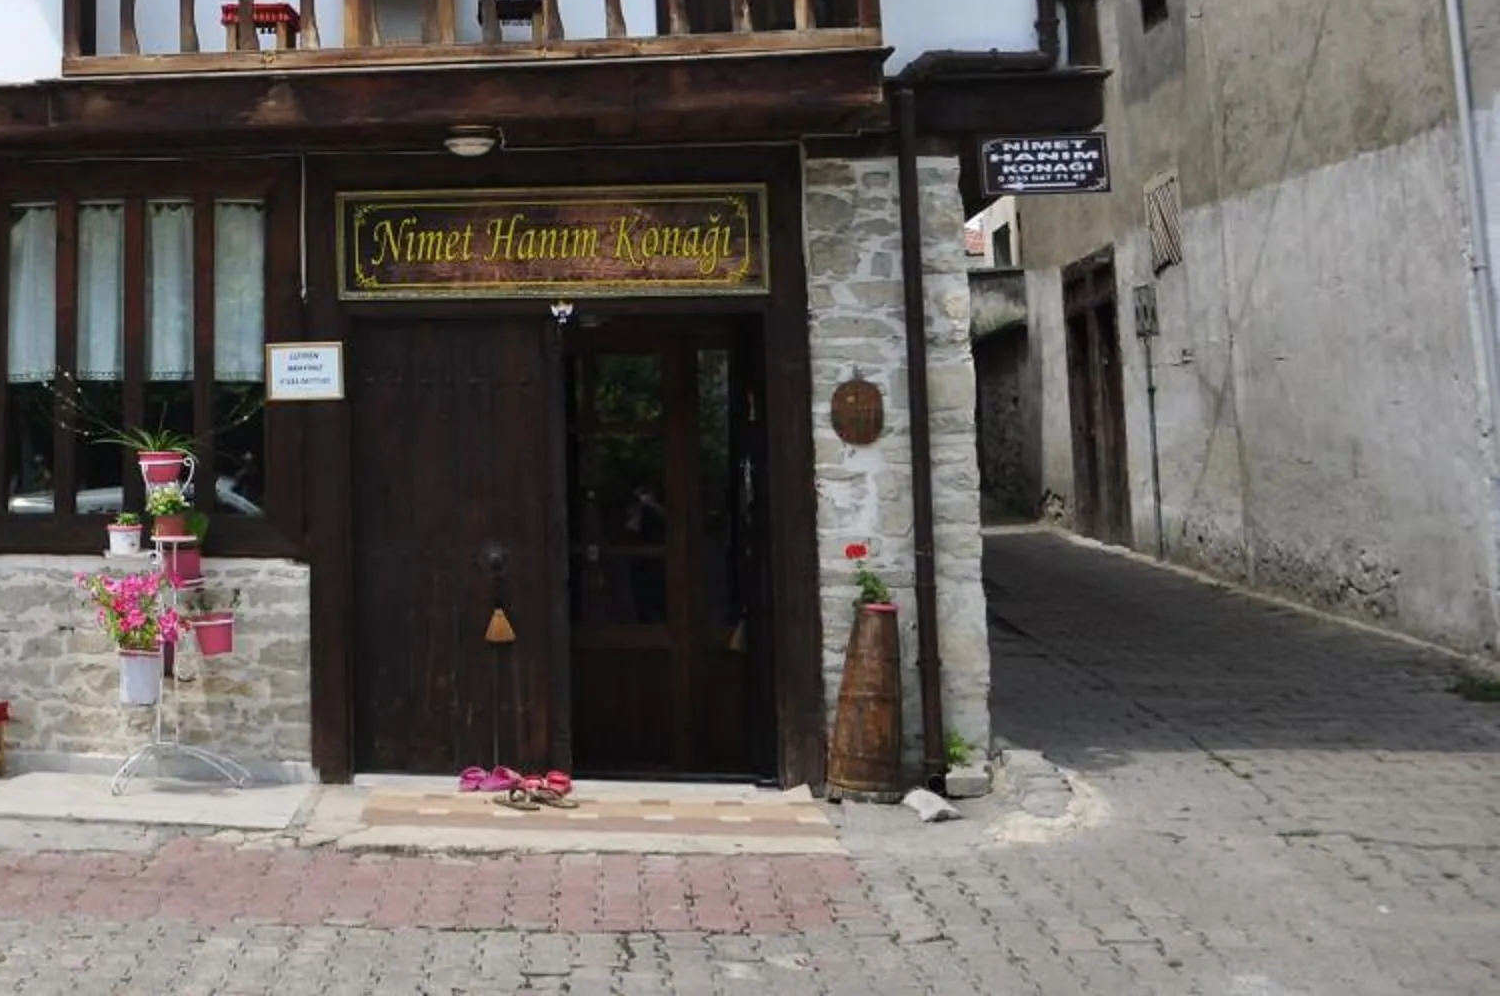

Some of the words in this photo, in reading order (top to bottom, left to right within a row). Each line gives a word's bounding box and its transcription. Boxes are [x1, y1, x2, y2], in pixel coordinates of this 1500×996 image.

[1003, 140, 1086, 150] NİMET
[990, 151, 1099, 162] HANIM
[371, 217, 475, 266] Nimet
[484, 213, 598, 262] Hanım
[610, 213, 732, 274] Konağı
